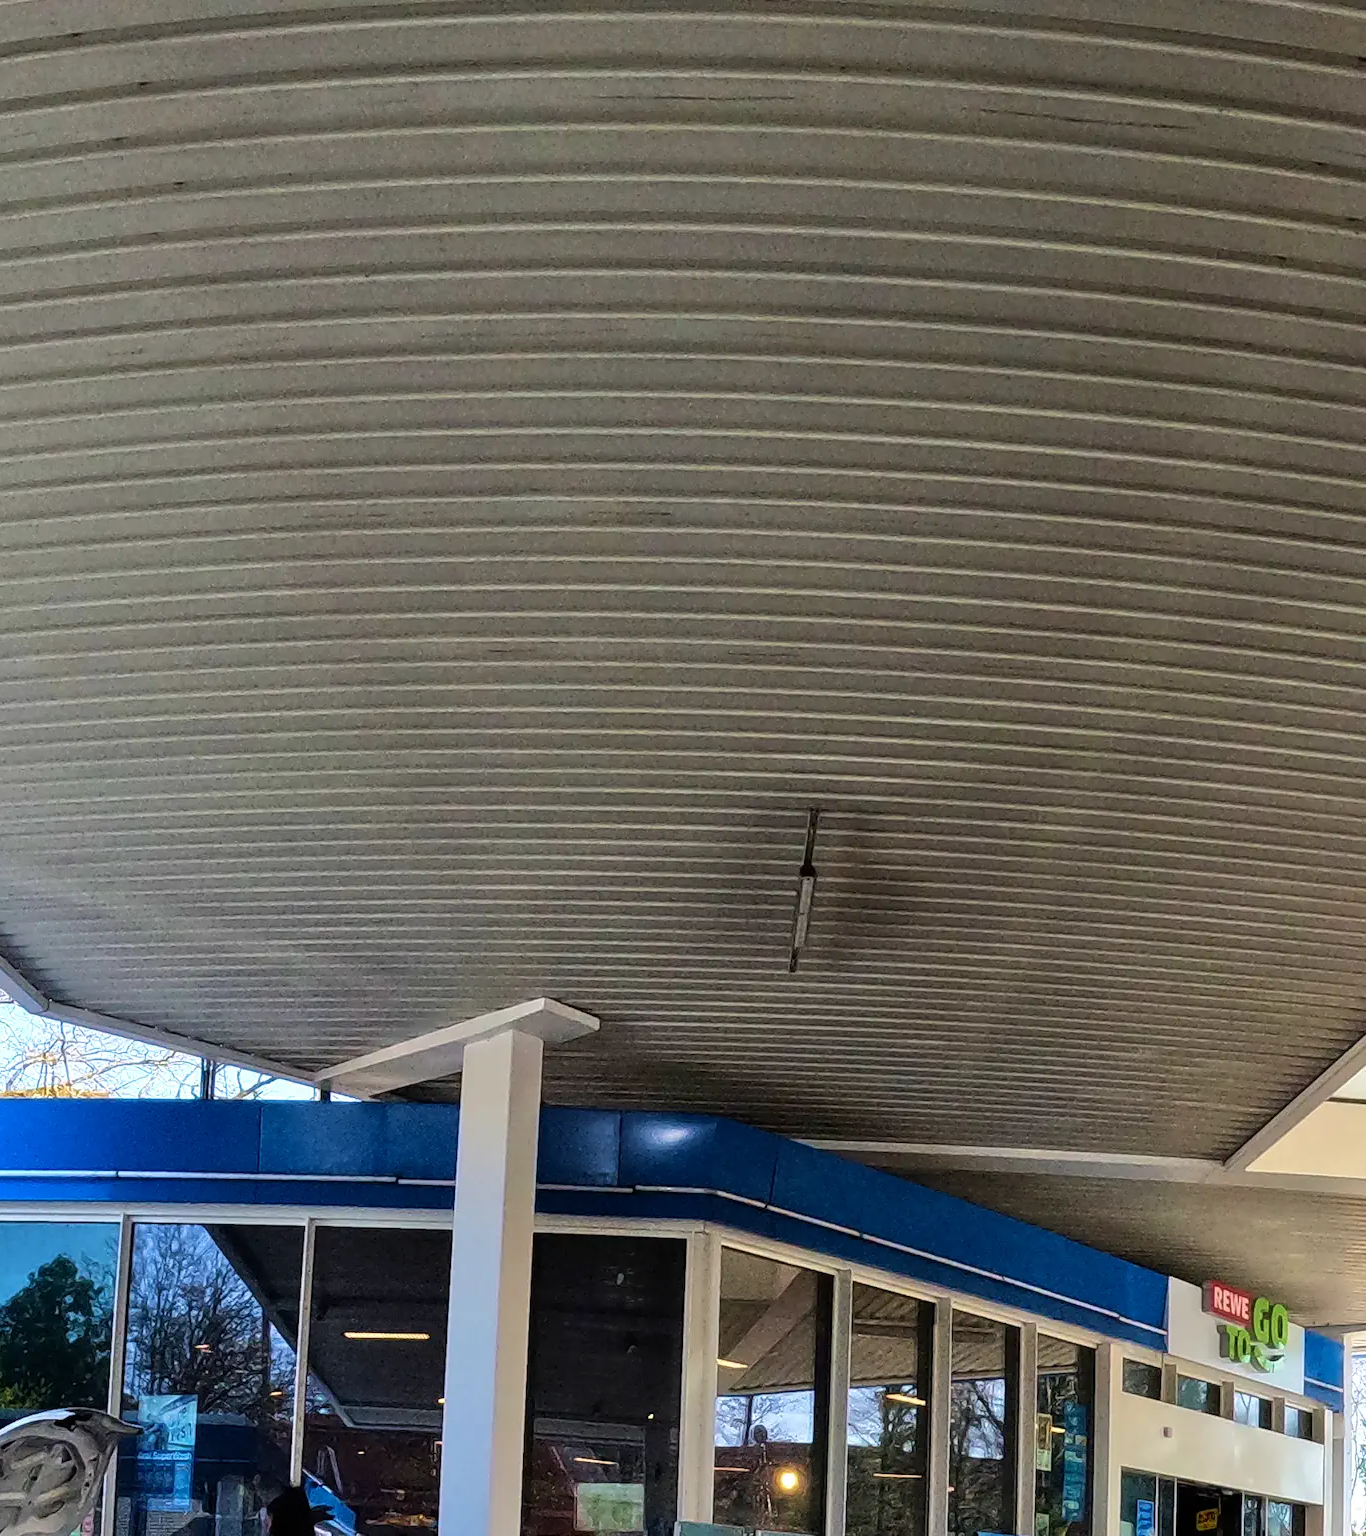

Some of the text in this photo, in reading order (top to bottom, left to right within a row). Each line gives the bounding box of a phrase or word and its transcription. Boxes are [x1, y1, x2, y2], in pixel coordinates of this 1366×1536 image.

[1214, 1286, 1249, 1320] REWE
[1253, 1297, 1289, 1348] GO
[1223, 1324, 1251, 1363] TO
